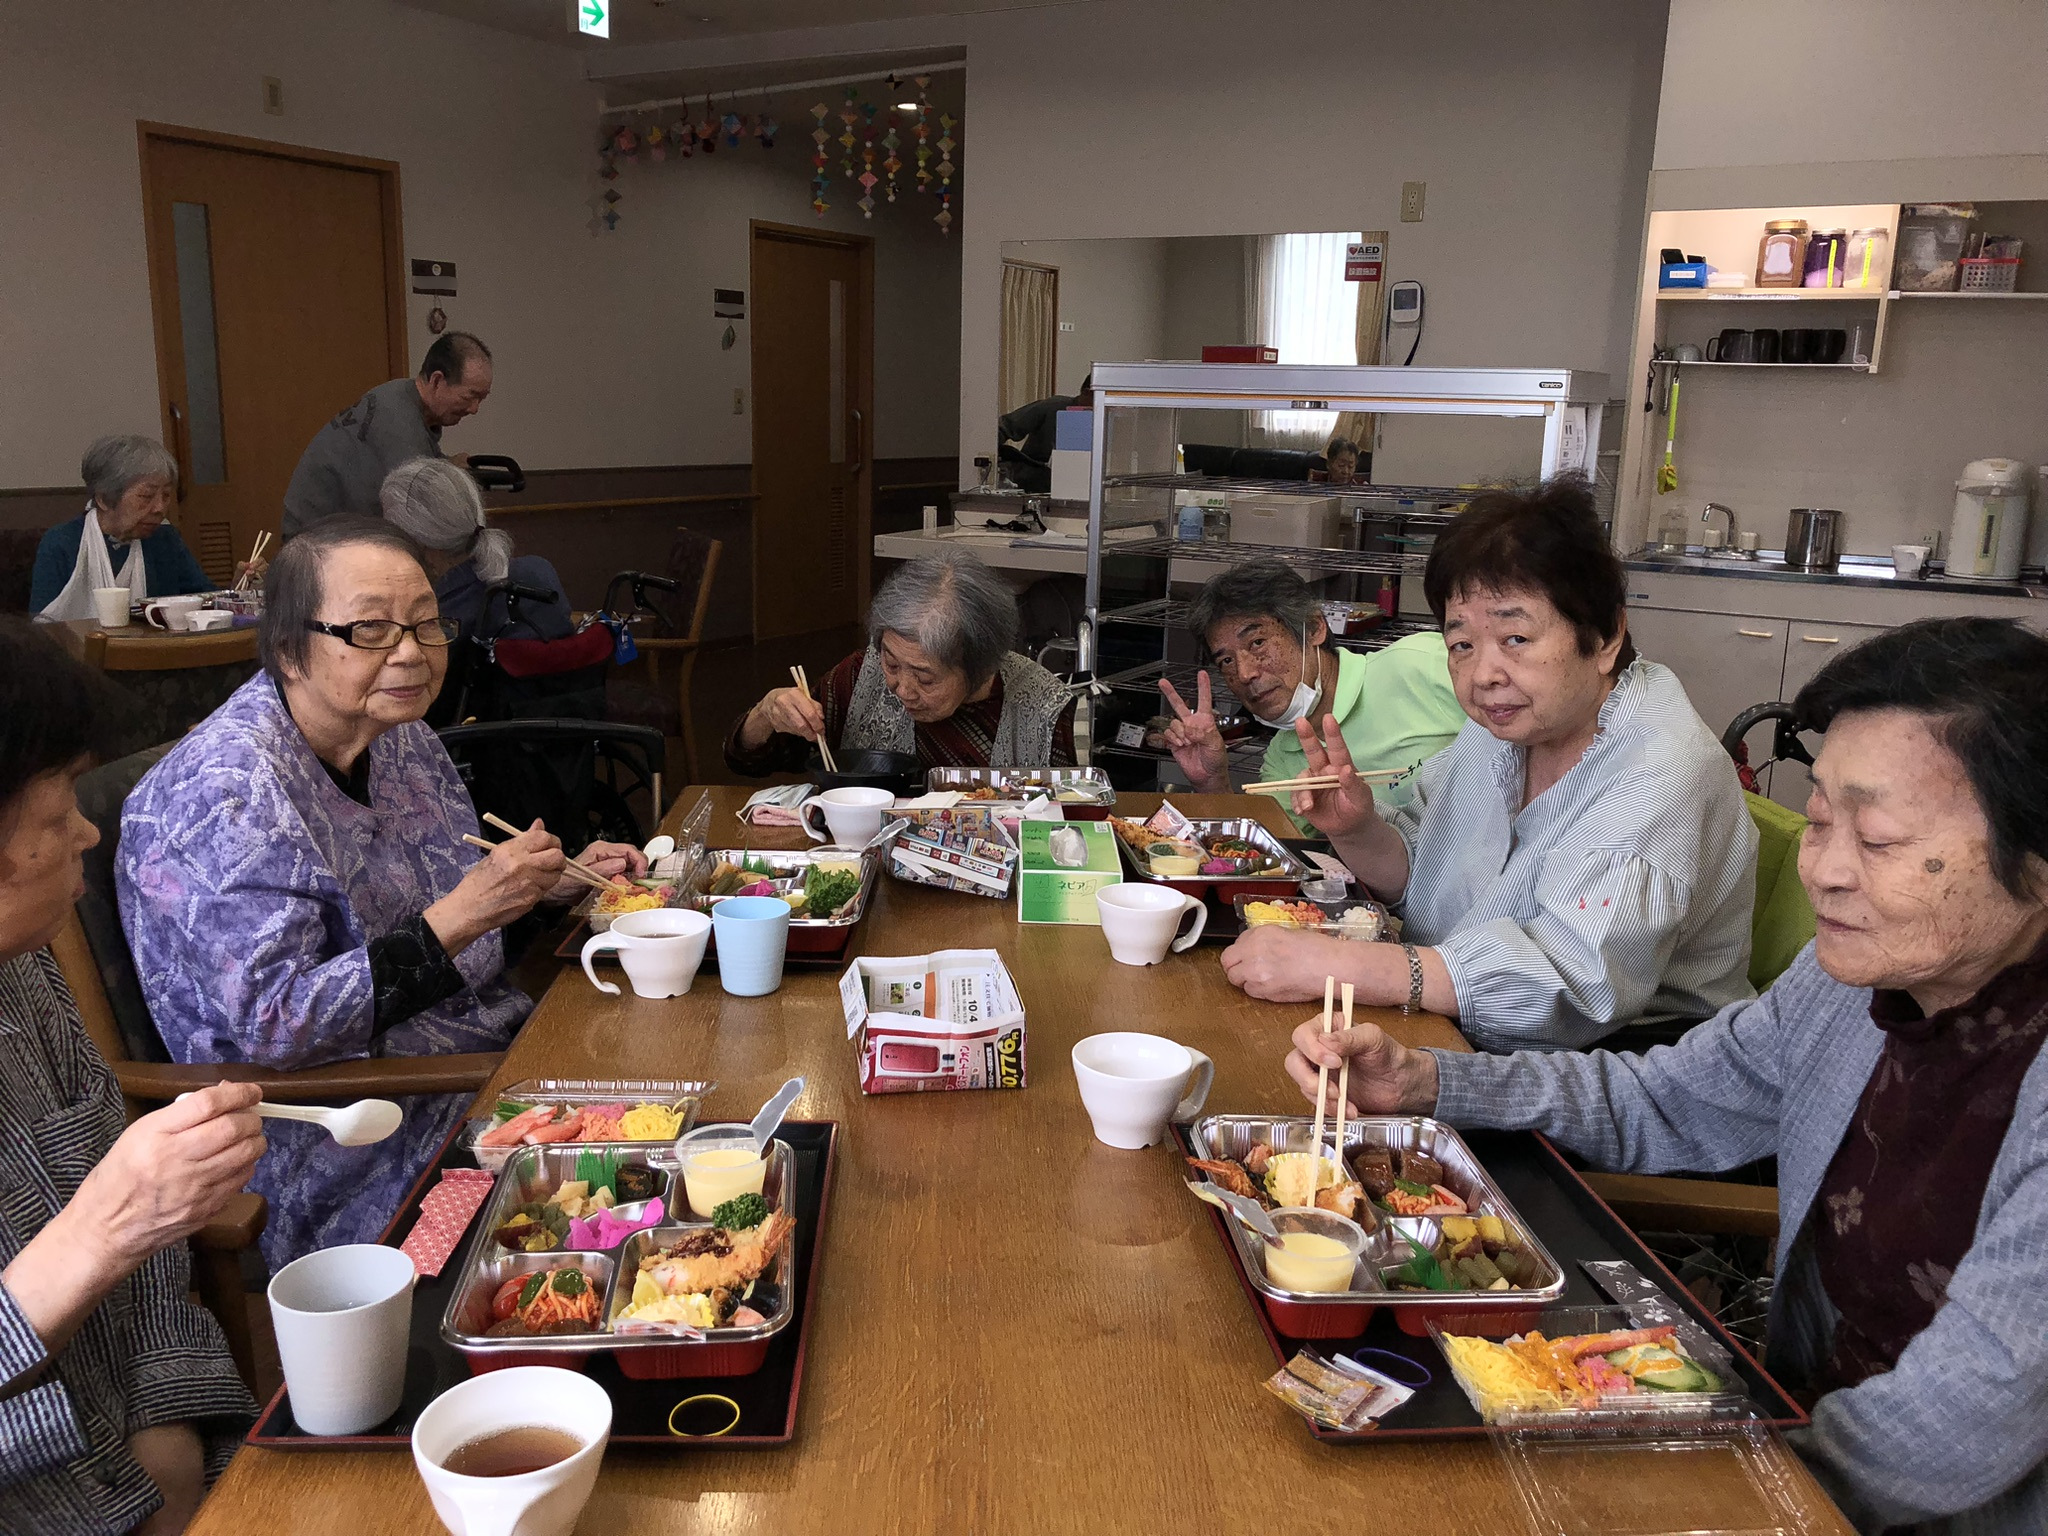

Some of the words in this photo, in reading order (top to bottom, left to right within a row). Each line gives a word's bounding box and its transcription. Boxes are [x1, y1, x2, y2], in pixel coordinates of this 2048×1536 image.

[1358, 246, 1380, 254] AED
[1057, 880, 1086, 890] ネピア
[968, 999, 978, 1023] 10/4
